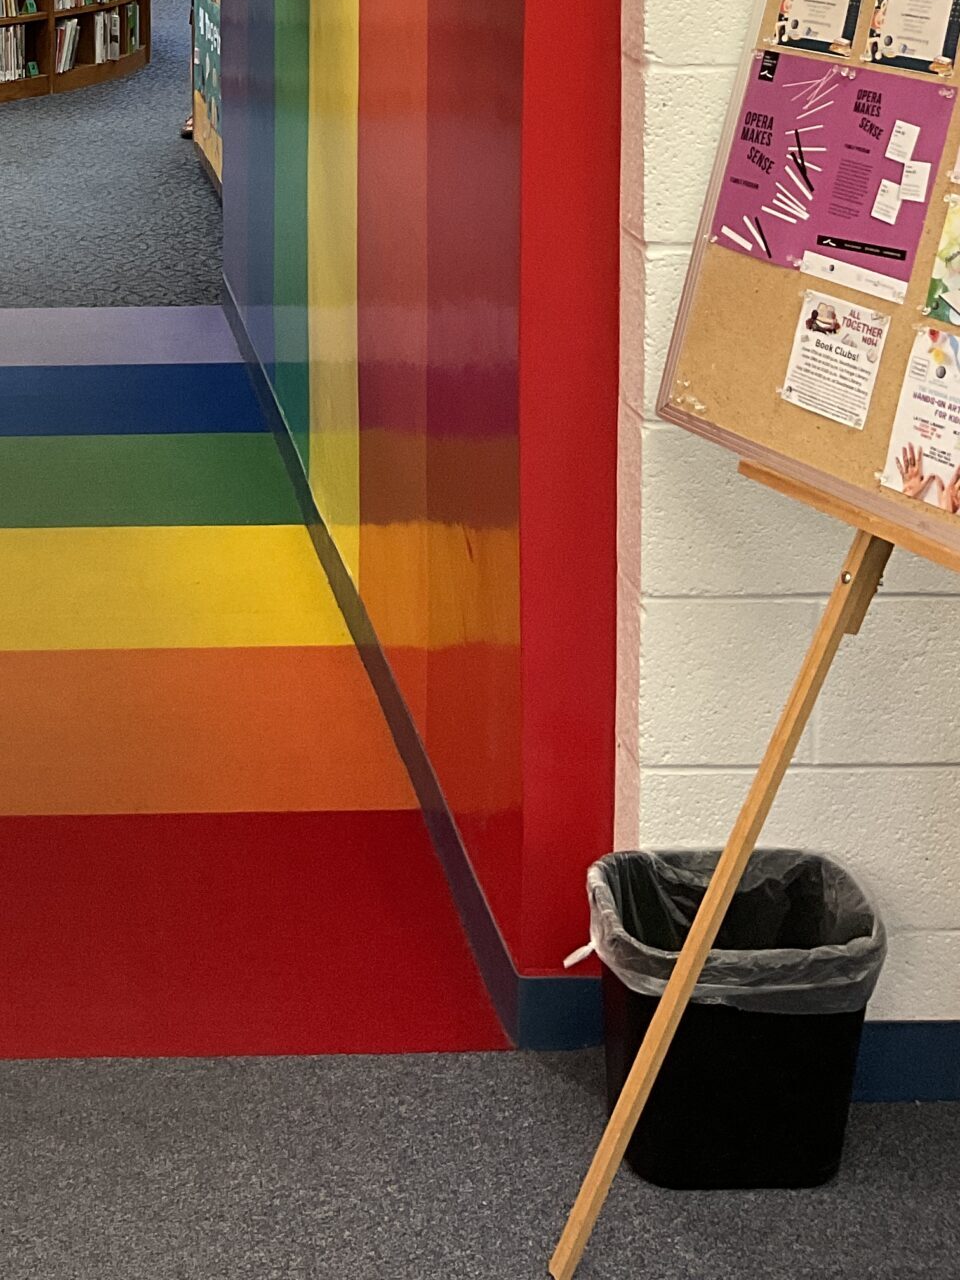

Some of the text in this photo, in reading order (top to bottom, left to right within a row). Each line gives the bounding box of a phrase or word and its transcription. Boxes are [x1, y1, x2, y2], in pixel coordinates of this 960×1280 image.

[857, 89, 882, 105] OPERA
[853, 101, 882, 118] MAKES
[744, 111, 775, 131] OPERA
[858, 117, 884, 141] SENSE
[741, 126, 773, 147] MAKES
[746, 146, 776, 175] SENSE
[849, 309, 861, 320] ALL
[841, 316, 883, 338] TOGETHER
[815, 338, 860, 361] Book Clubs!
[861, 335, 878, 347] NOW
